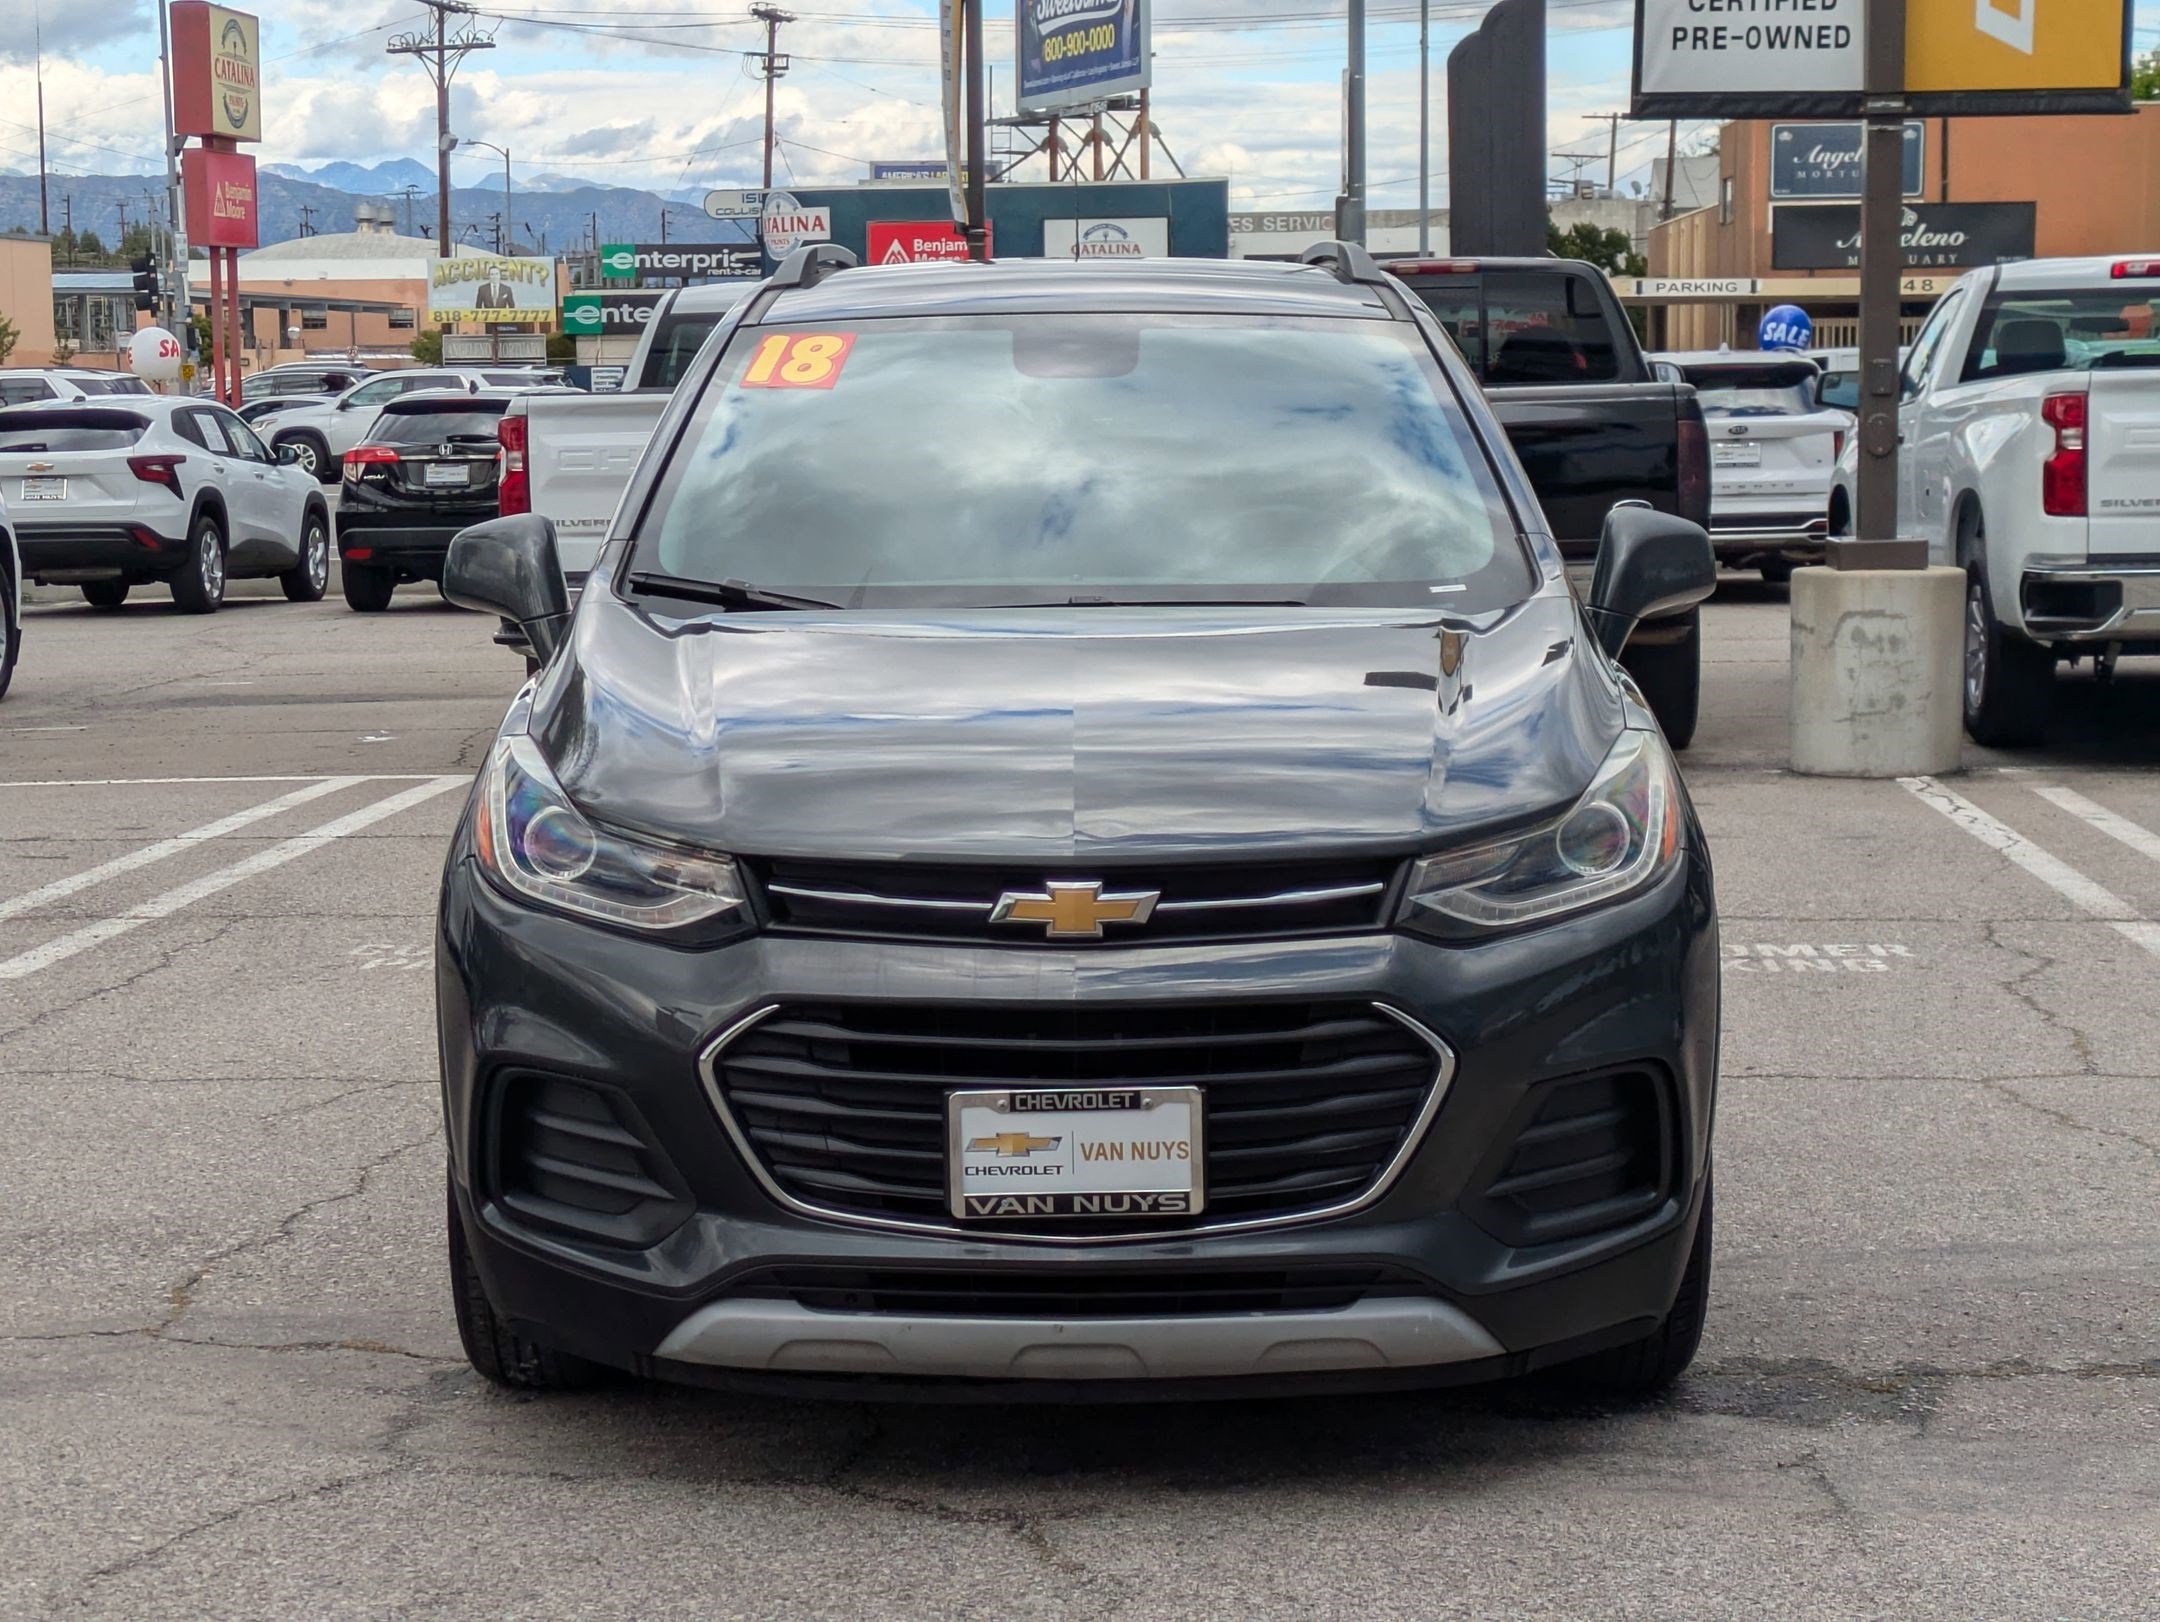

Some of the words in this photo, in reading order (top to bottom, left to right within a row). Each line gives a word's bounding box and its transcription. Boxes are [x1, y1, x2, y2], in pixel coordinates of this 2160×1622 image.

[1044, 23, 1115, 62] 800-900-0000
[1672, 25, 1851, 50] PRE-OWNED
[214, 57, 255, 88] CATALINA
[225, 181, 252, 203] Benjamin
[226, 199, 245, 220] Moore
[1263, 216, 1334, 231] SERVIC
[1071, 243, 1141, 256] CATALINA
[432, 257, 550, 288] ACCIDENT?
[1655, 281, 1738, 293] PARKING
[1903, 279, 1934, 291] 48
[433, 310, 551, 322] 818-777-7777
[1763, 321, 1810, 347] SALE
[745, 335, 845, 385] 18
[1015, 1093, 1135, 1111] CHEVROLET
[1080, 1142, 1124, 1161] VAN
[1131, 1141, 1190, 1161] NUYS
[965, 1165, 1064, 1176] CHEVROLET
[968, 1196, 1055, 1215] VAN
[1073, 1193, 1186, 1213] NUYS
